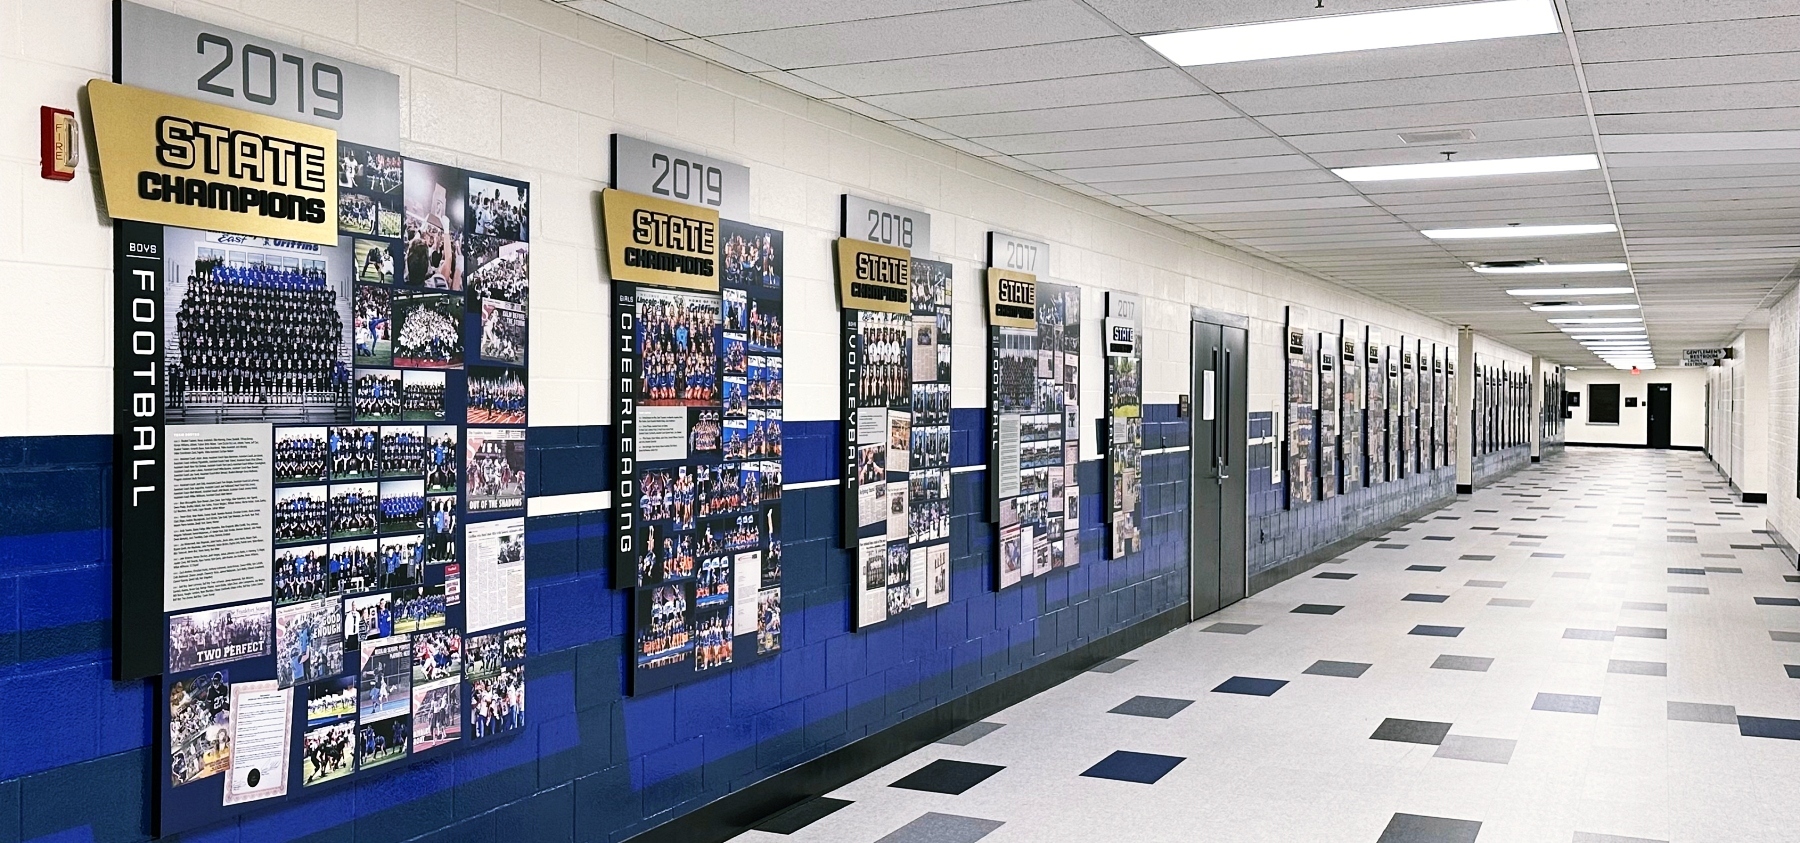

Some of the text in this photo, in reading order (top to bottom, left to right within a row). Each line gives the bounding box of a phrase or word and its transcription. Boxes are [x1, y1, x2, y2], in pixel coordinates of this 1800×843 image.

[197, 32, 343, 120] 2019
[55, 123, 63, 161] FIRE
[156, 116, 326, 192] STATE
[652, 153, 722, 206] 2019
[138, 171, 326, 223] CHAMPIONS
[633, 209, 714, 255] STATE
[868, 209, 913, 249] 2018
[129, 242, 157, 254] BOYS
[625, 247, 714, 277] CHAMPIONS
[1007, 241, 1037, 272] 2017
[856, 252, 908, 285] STATE
[851, 282, 908, 303] CHAMPIONS
[999, 279, 1035, 305] STATE
[1118, 300, 1134, 320] 2017
[1113, 326, 1134, 342] STATE
[132, 269, 156, 507] FOOTBALL
[848, 335, 856, 489] VOLLEYBALL
[621, 313, 633, 553] CHEERLEADING
[469, 498, 522, 510] OUT OF THE SHADOWS
[313, 624, 341, 639] ENOUGH
[323, 613, 341, 625] GOOD
[197, 648, 221, 662] TWO
[223, 641, 264, 657] PERFECT
